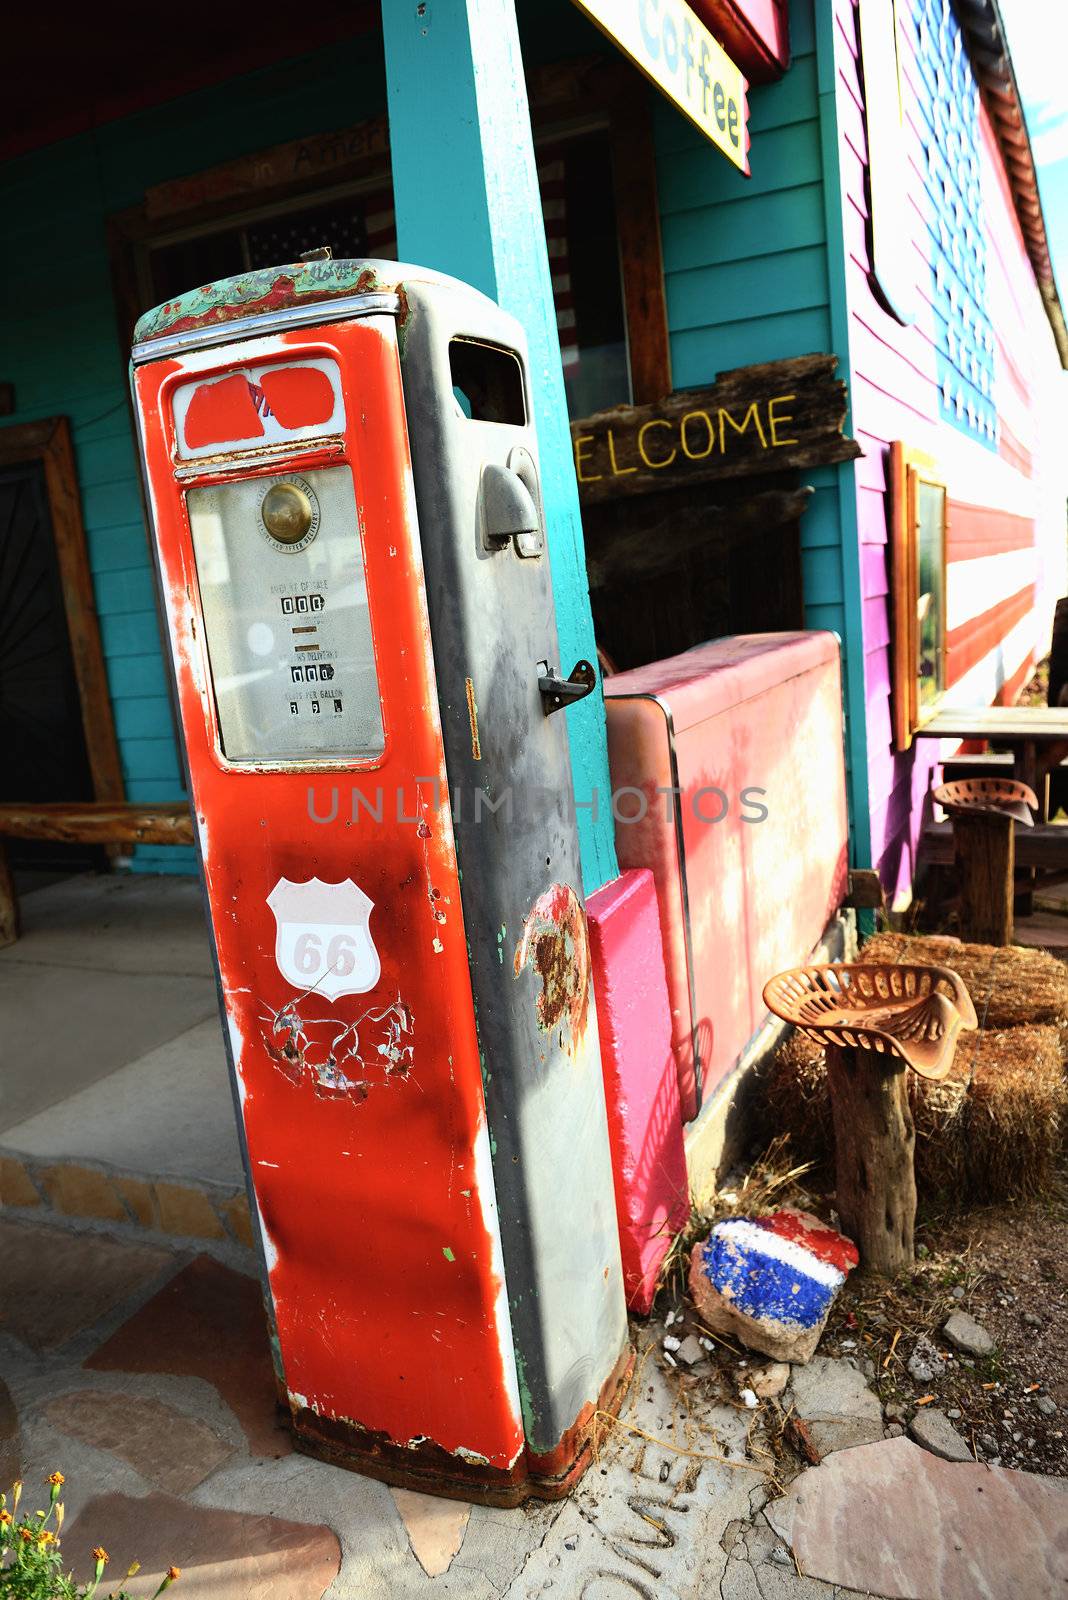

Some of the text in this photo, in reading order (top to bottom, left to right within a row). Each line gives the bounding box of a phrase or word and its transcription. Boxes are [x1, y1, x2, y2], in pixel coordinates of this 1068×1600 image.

[638, 0, 739, 148] Coffee
[291, 127, 388, 174] Amer
[574, 394, 799, 483] ELCOME
[303, 512, 319, 544] DELIVERY
[293, 933, 357, 977] 66
